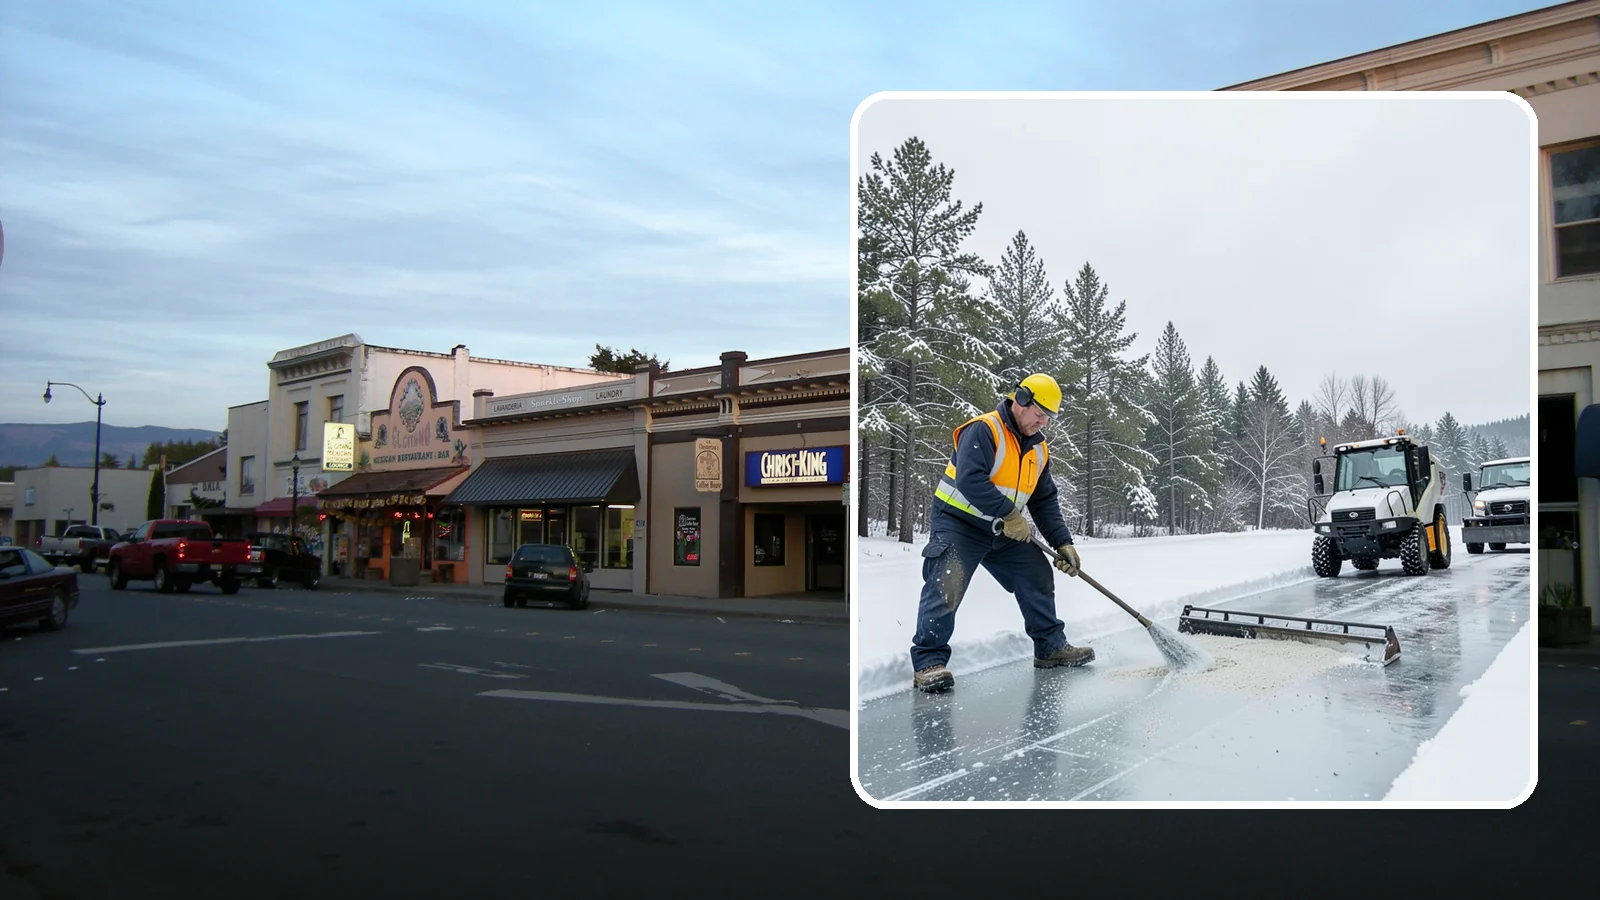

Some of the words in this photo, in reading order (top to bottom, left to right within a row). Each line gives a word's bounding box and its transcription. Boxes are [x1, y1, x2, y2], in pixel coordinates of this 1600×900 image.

[493, 402, 522, 413] LAVANDERIA
[531, 399, 561, 409] Sparkle
[561, 394, 583, 404] Shop
[595, 389, 623, 400] LAUNDRY
[374, 455, 396, 464] MEXICAN
[397, 451, 433, 462] RESTAURANT
[438, 450, 450, 459] BAR
[760, 452, 797, 478] CHRIST
[799, 450, 827, 476] KING
